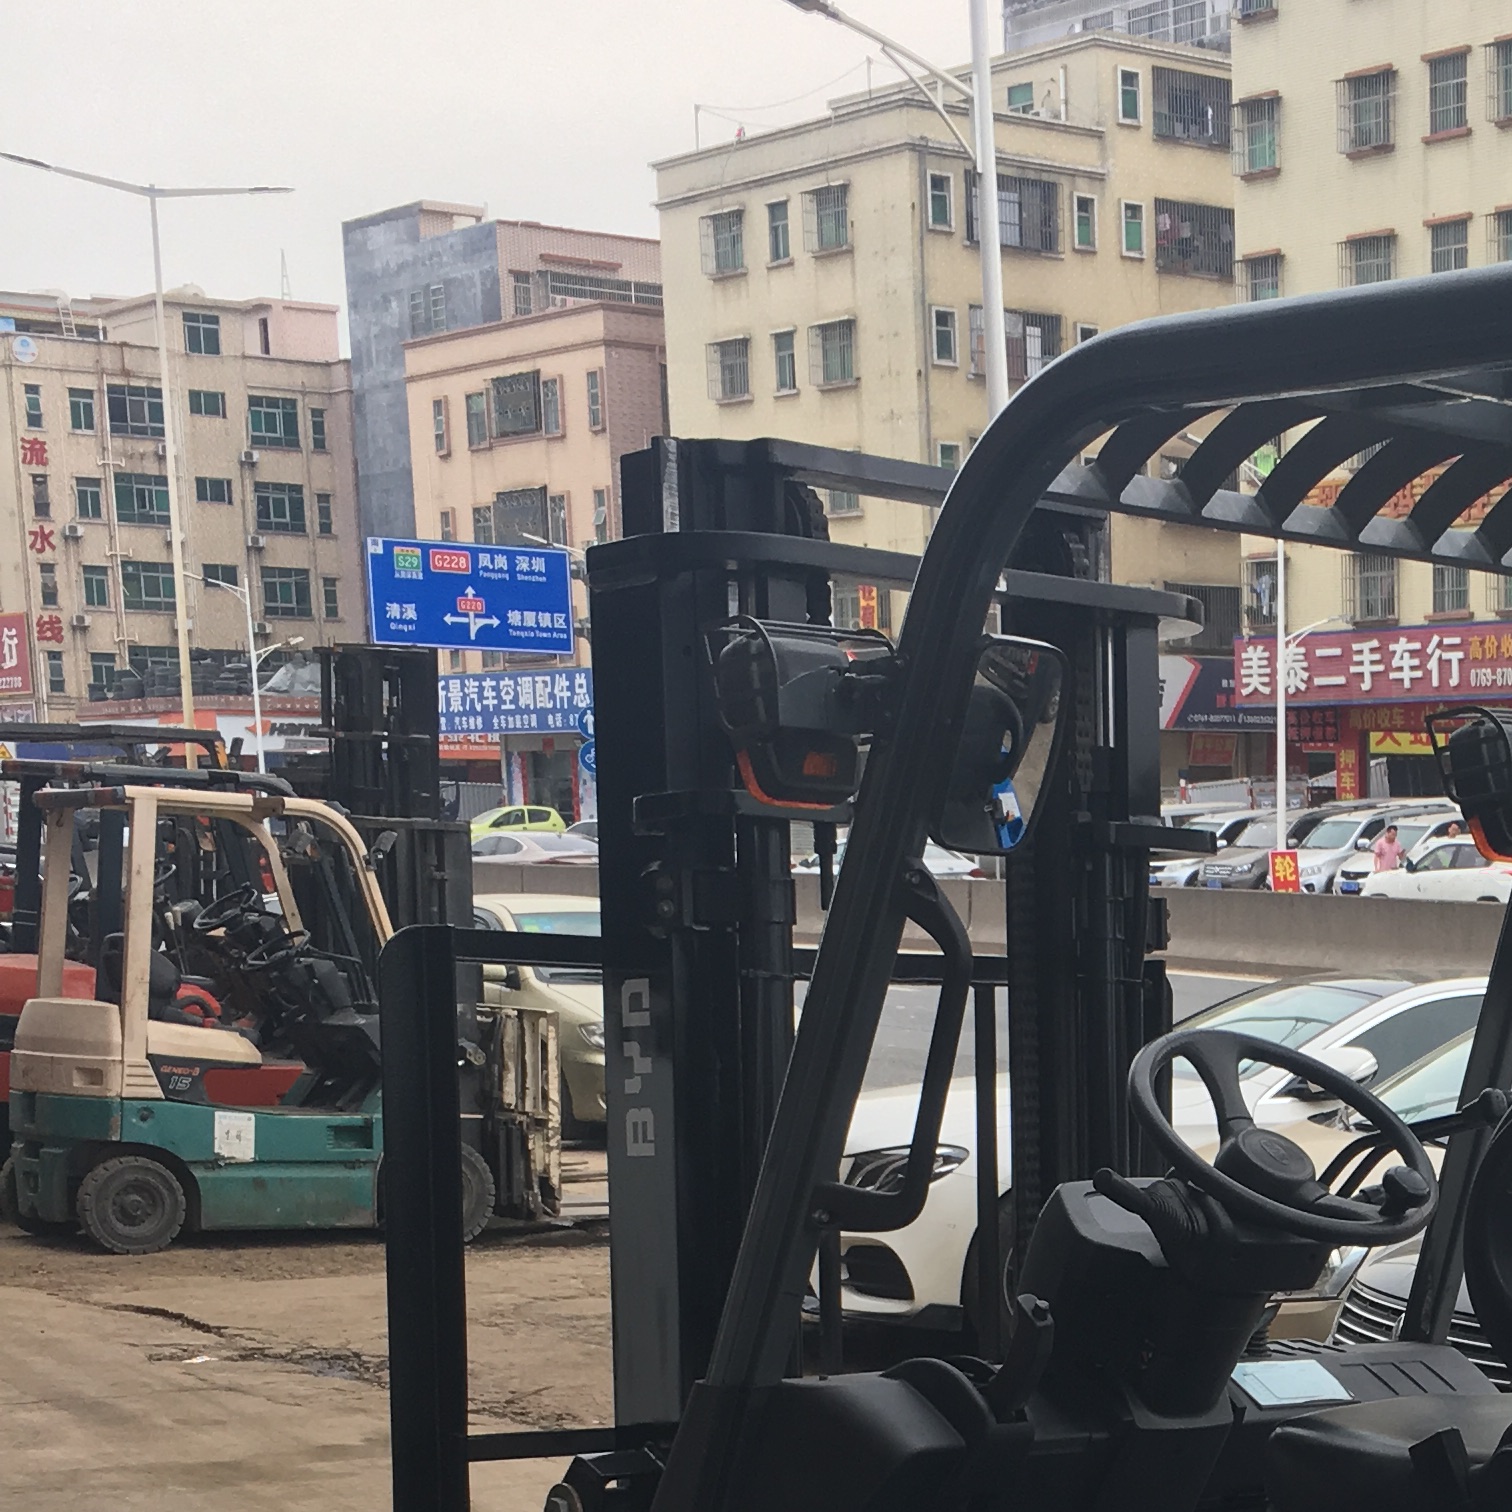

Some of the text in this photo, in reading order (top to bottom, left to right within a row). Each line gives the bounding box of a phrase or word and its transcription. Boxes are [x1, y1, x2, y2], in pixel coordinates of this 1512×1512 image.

[20, 437, 64, 644] 流水线
[398, 556, 419, 568] S29
[434, 555, 467, 569] G228
[478, 553, 546, 573] 凤岗 深圳
[517, 573, 547, 582] Shenzhen
[386, 602, 417, 621] 清溪
[460, 600, 483, 610] G220
[507, 610, 567, 629] 塘厦镇区
[2, 627, 18, 669] 行
[1240, 634, 1465, 696] 美泰二手车行
[1274, 855, 1296, 892] 轮
[621, 978, 655, 1156] BYD
[169, 1076, 191, 1090] 15
